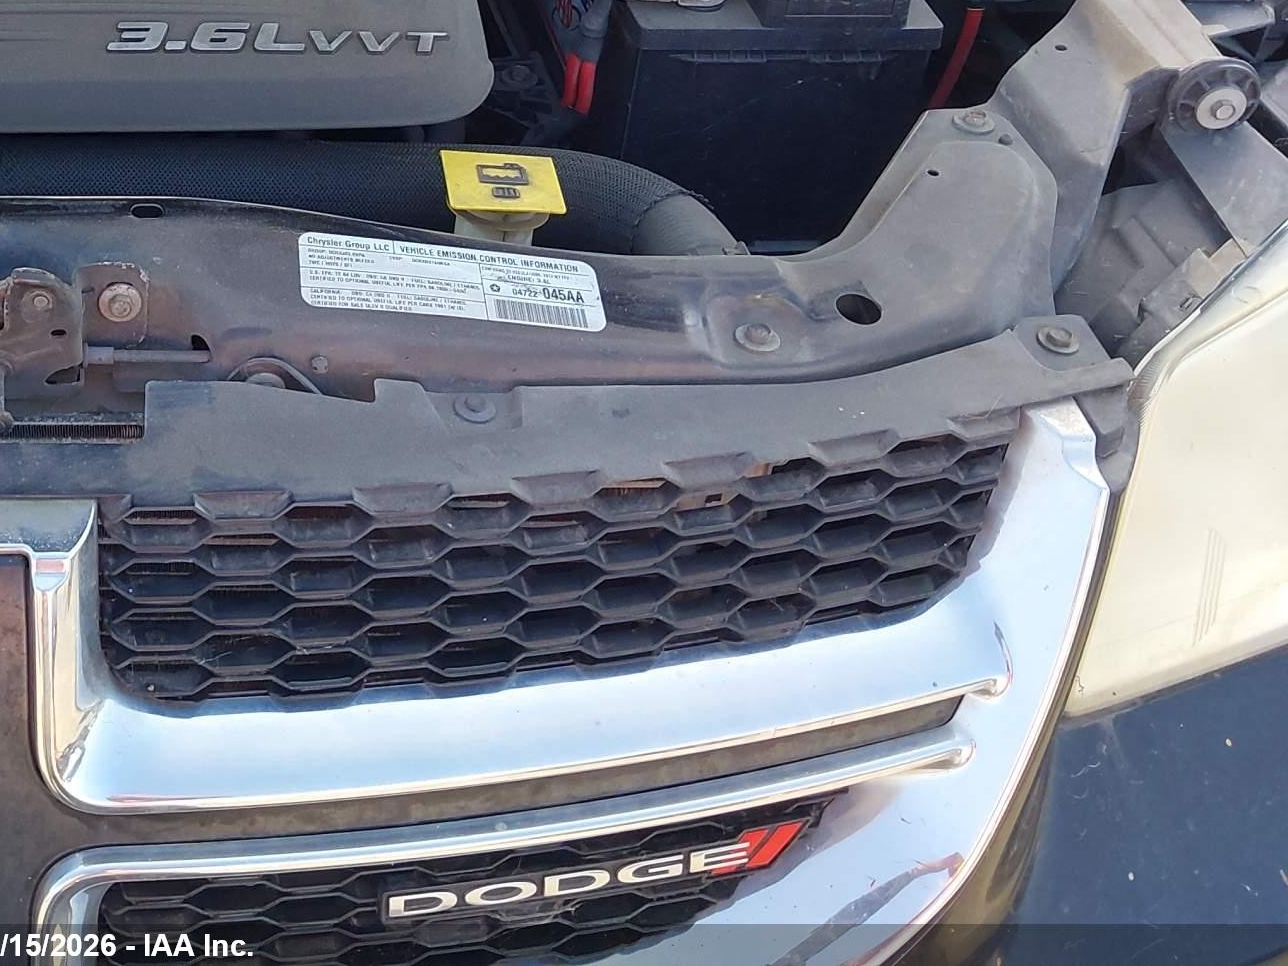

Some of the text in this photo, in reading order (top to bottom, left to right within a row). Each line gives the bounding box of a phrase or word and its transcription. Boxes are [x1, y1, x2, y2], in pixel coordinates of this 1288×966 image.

[307, 236, 390, 251] Chrysler Group LLC
[399, 245, 578, 272] VEHICLE EMISSION CONTROL INFORMATION
[542, 287, 584, 303] 045AA
[388, 842, 750, 918] DODGE
